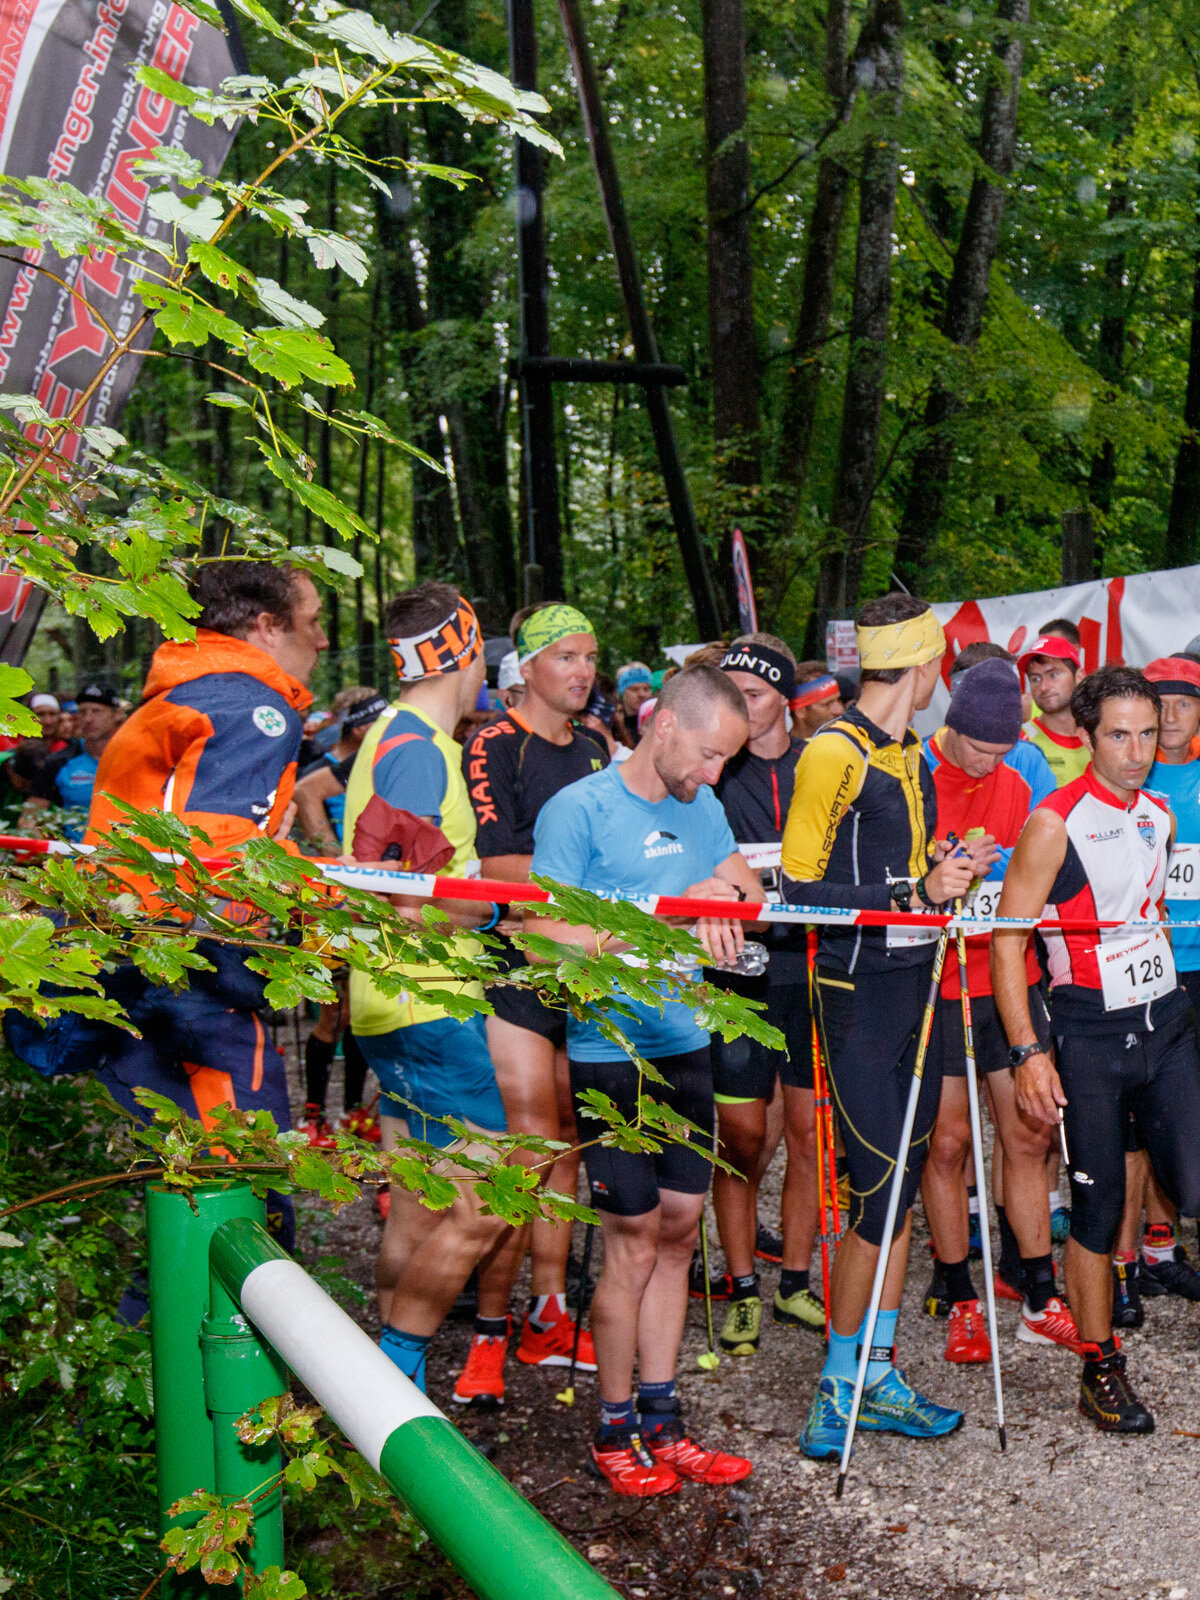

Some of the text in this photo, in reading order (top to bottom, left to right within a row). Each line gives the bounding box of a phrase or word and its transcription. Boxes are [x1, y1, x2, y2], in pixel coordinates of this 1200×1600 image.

[469, 721, 516, 825] KARPOS
[644, 842, 684, 859] skinfit
[1168, 863, 1195, 883] 40
[1124, 954, 1163, 987] 128
